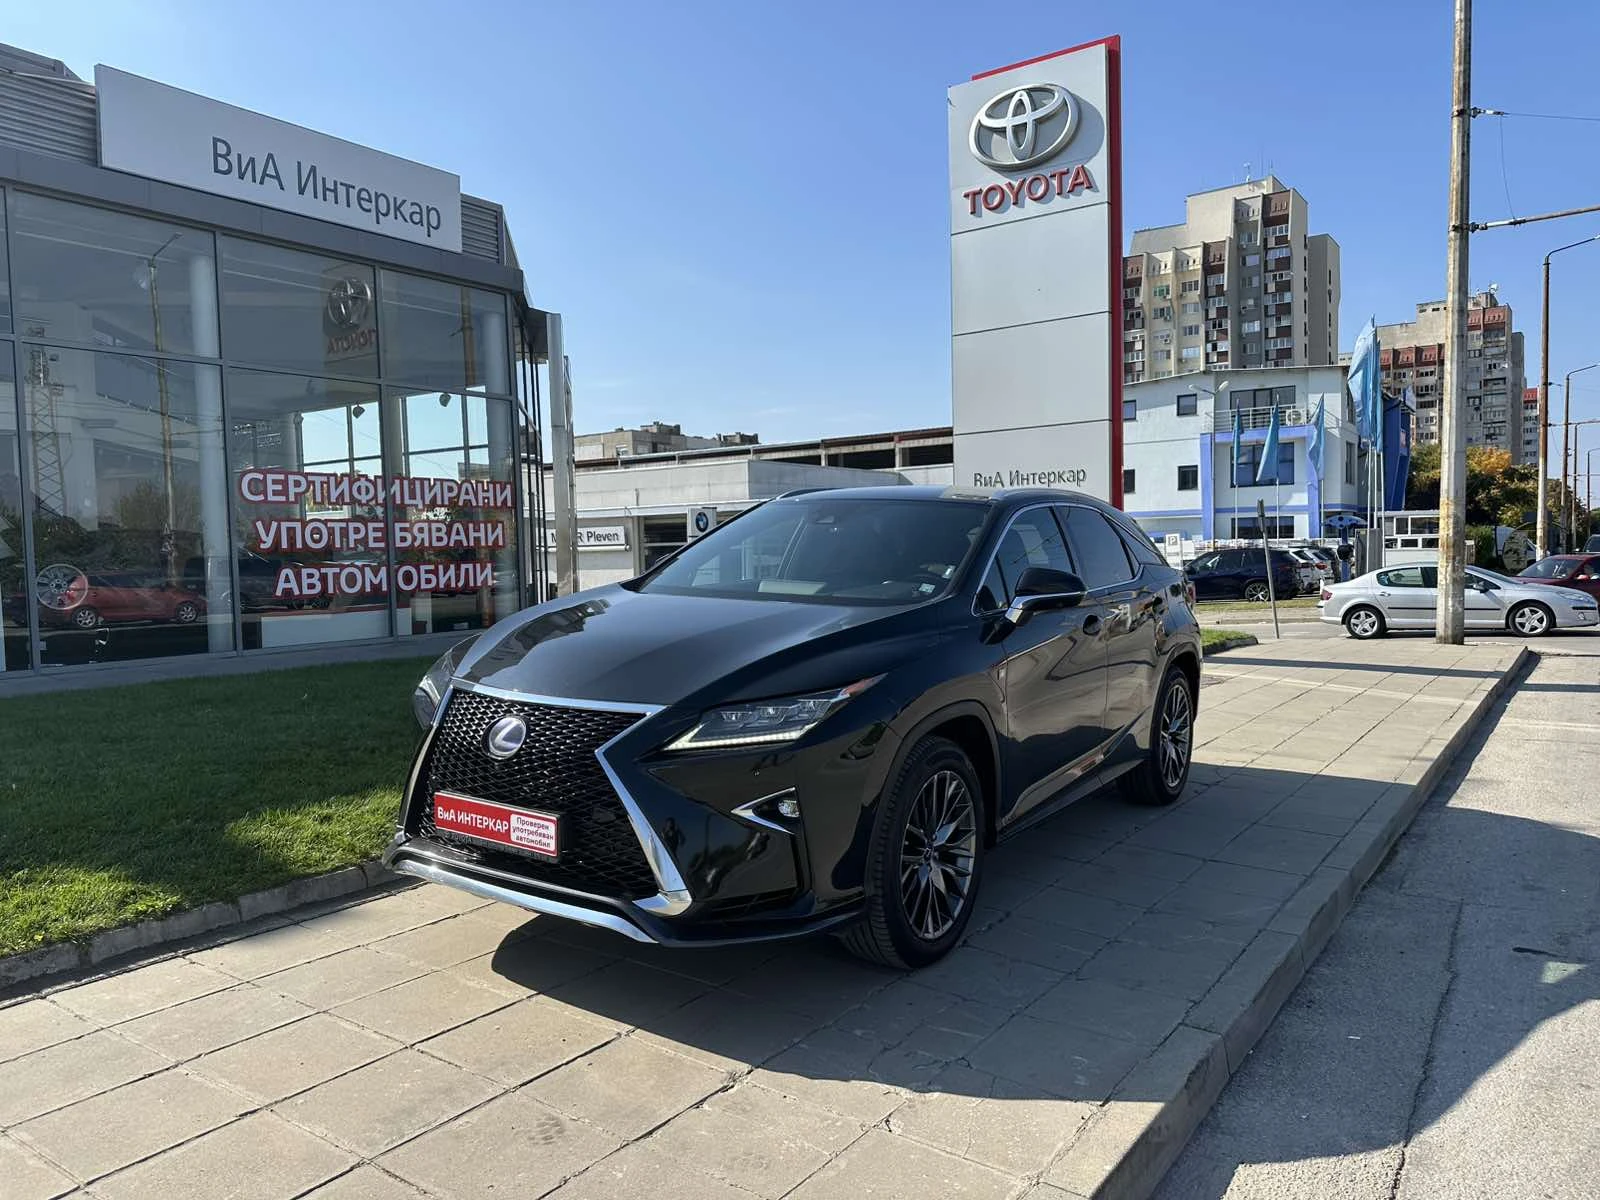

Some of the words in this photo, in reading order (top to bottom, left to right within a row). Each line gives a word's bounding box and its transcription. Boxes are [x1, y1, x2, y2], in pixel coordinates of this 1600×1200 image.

[212, 136, 285, 191] ВиА
[296, 160, 442, 238] Интеркар
[963, 164, 1093, 215] TOYOTA
[240, 471, 513, 508] СЕРТИФИЦИРАНИ
[1008, 468, 1087, 488] Интеркар
[586, 530, 620, 543] Pleven
[437, 806, 457, 823] ВиА
[457, 811, 509, 833] ИНТЕРКАР
[516, 816, 549, 830] Проверен
[515, 835, 551, 848] автомобил
